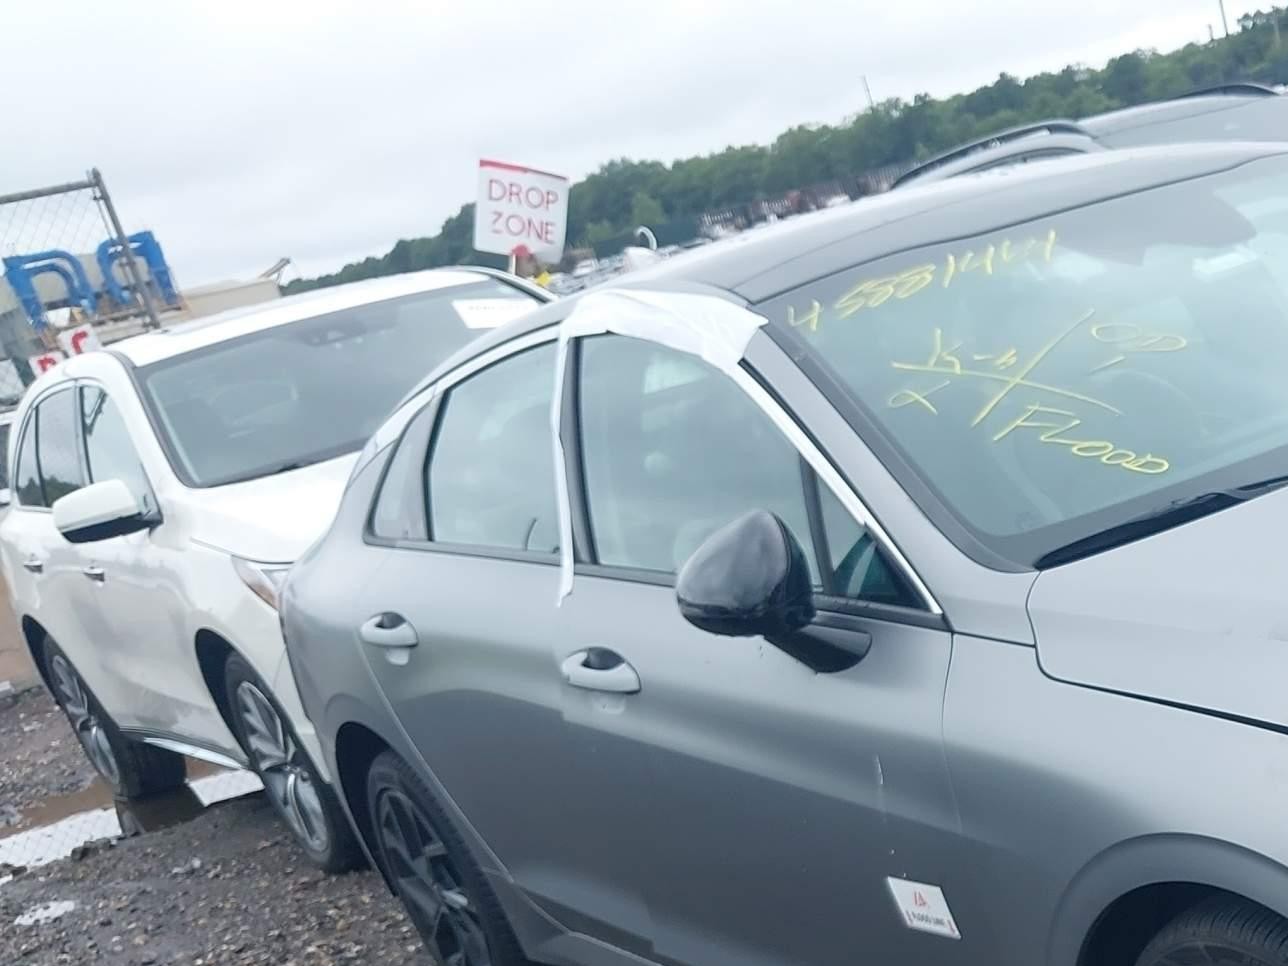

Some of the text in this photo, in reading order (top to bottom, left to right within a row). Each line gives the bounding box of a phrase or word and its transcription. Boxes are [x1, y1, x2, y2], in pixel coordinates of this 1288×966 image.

[488, 179, 559, 210] DROP
[491, 211, 555, 244] ZONE
[993, 402, 1169, 474] FLOOD
